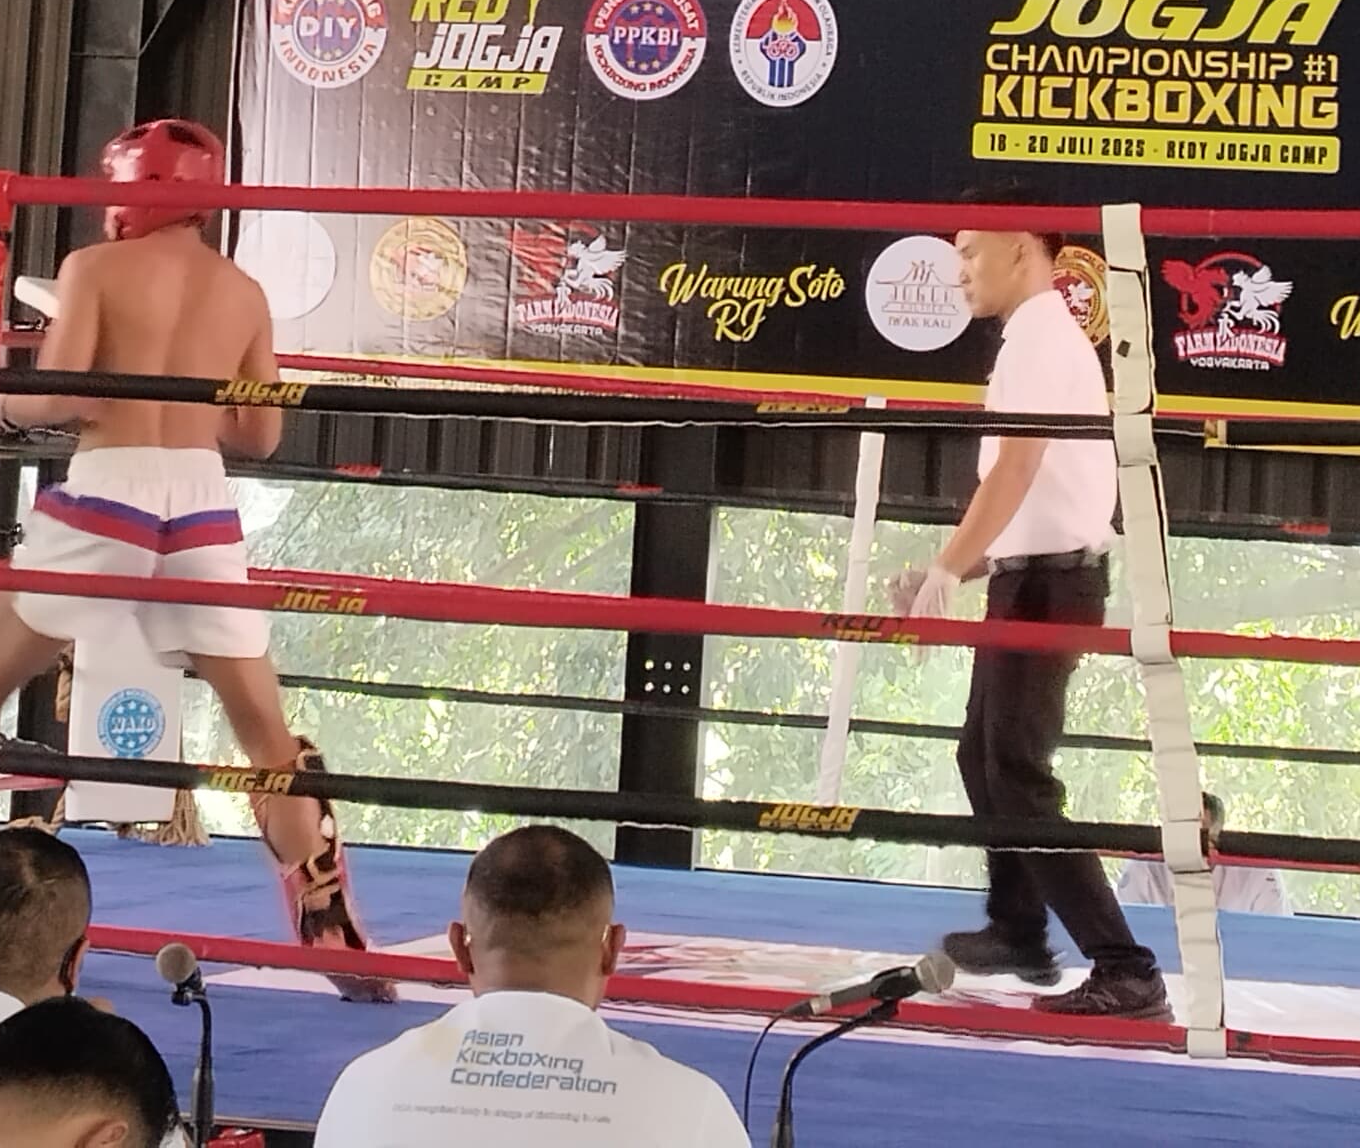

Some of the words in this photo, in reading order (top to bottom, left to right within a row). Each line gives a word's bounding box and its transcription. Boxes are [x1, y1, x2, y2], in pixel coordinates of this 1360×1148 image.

[299, 16, 357, 39] DIY
[613, 26, 679, 46] PPKBI
[818, 4, 835, 56] OLAHRAGA
[413, 23, 563, 71] JOGJA
[279, 39, 378, 83] INDONESIA
[593, 44, 648, 92] KICKBOXING
[649, 47, 698, 92] INDONESIA
[985, 43, 1294, 81] CHAMPIONSHIP
[1303, 53, 1339, 82] #1
[422, 75, 532, 89] CAMP
[777, 71, 824, 101] INDONESIA
[981, 73, 1340, 130] KICKBOXING
[989, 133, 1008, 152] 18
[1027, 135, 1049, 154] 20
[1056, 136, 1094, 156] JULI
[1101, 138, 1146, 158] 2025
[1166, 140, 1208, 160] REDY
[1216, 142, 1272, 163] JOGJA
[1279, 145, 1328, 165] CAMP
[659, 263, 786, 308] Warung
[785, 263, 845, 308] Soto
[888, 315, 920, 328] IWAK
[1174, 332, 1216, 357] FARM
[1189, 356, 1270, 371] YOGYAKARTA
[274, 589, 367, 616] JOGJA
[462, 1029, 524, 1047] Asian
[455, 1047, 584, 1073] Kickboxing
[450, 1068, 617, 1095] Confederation
